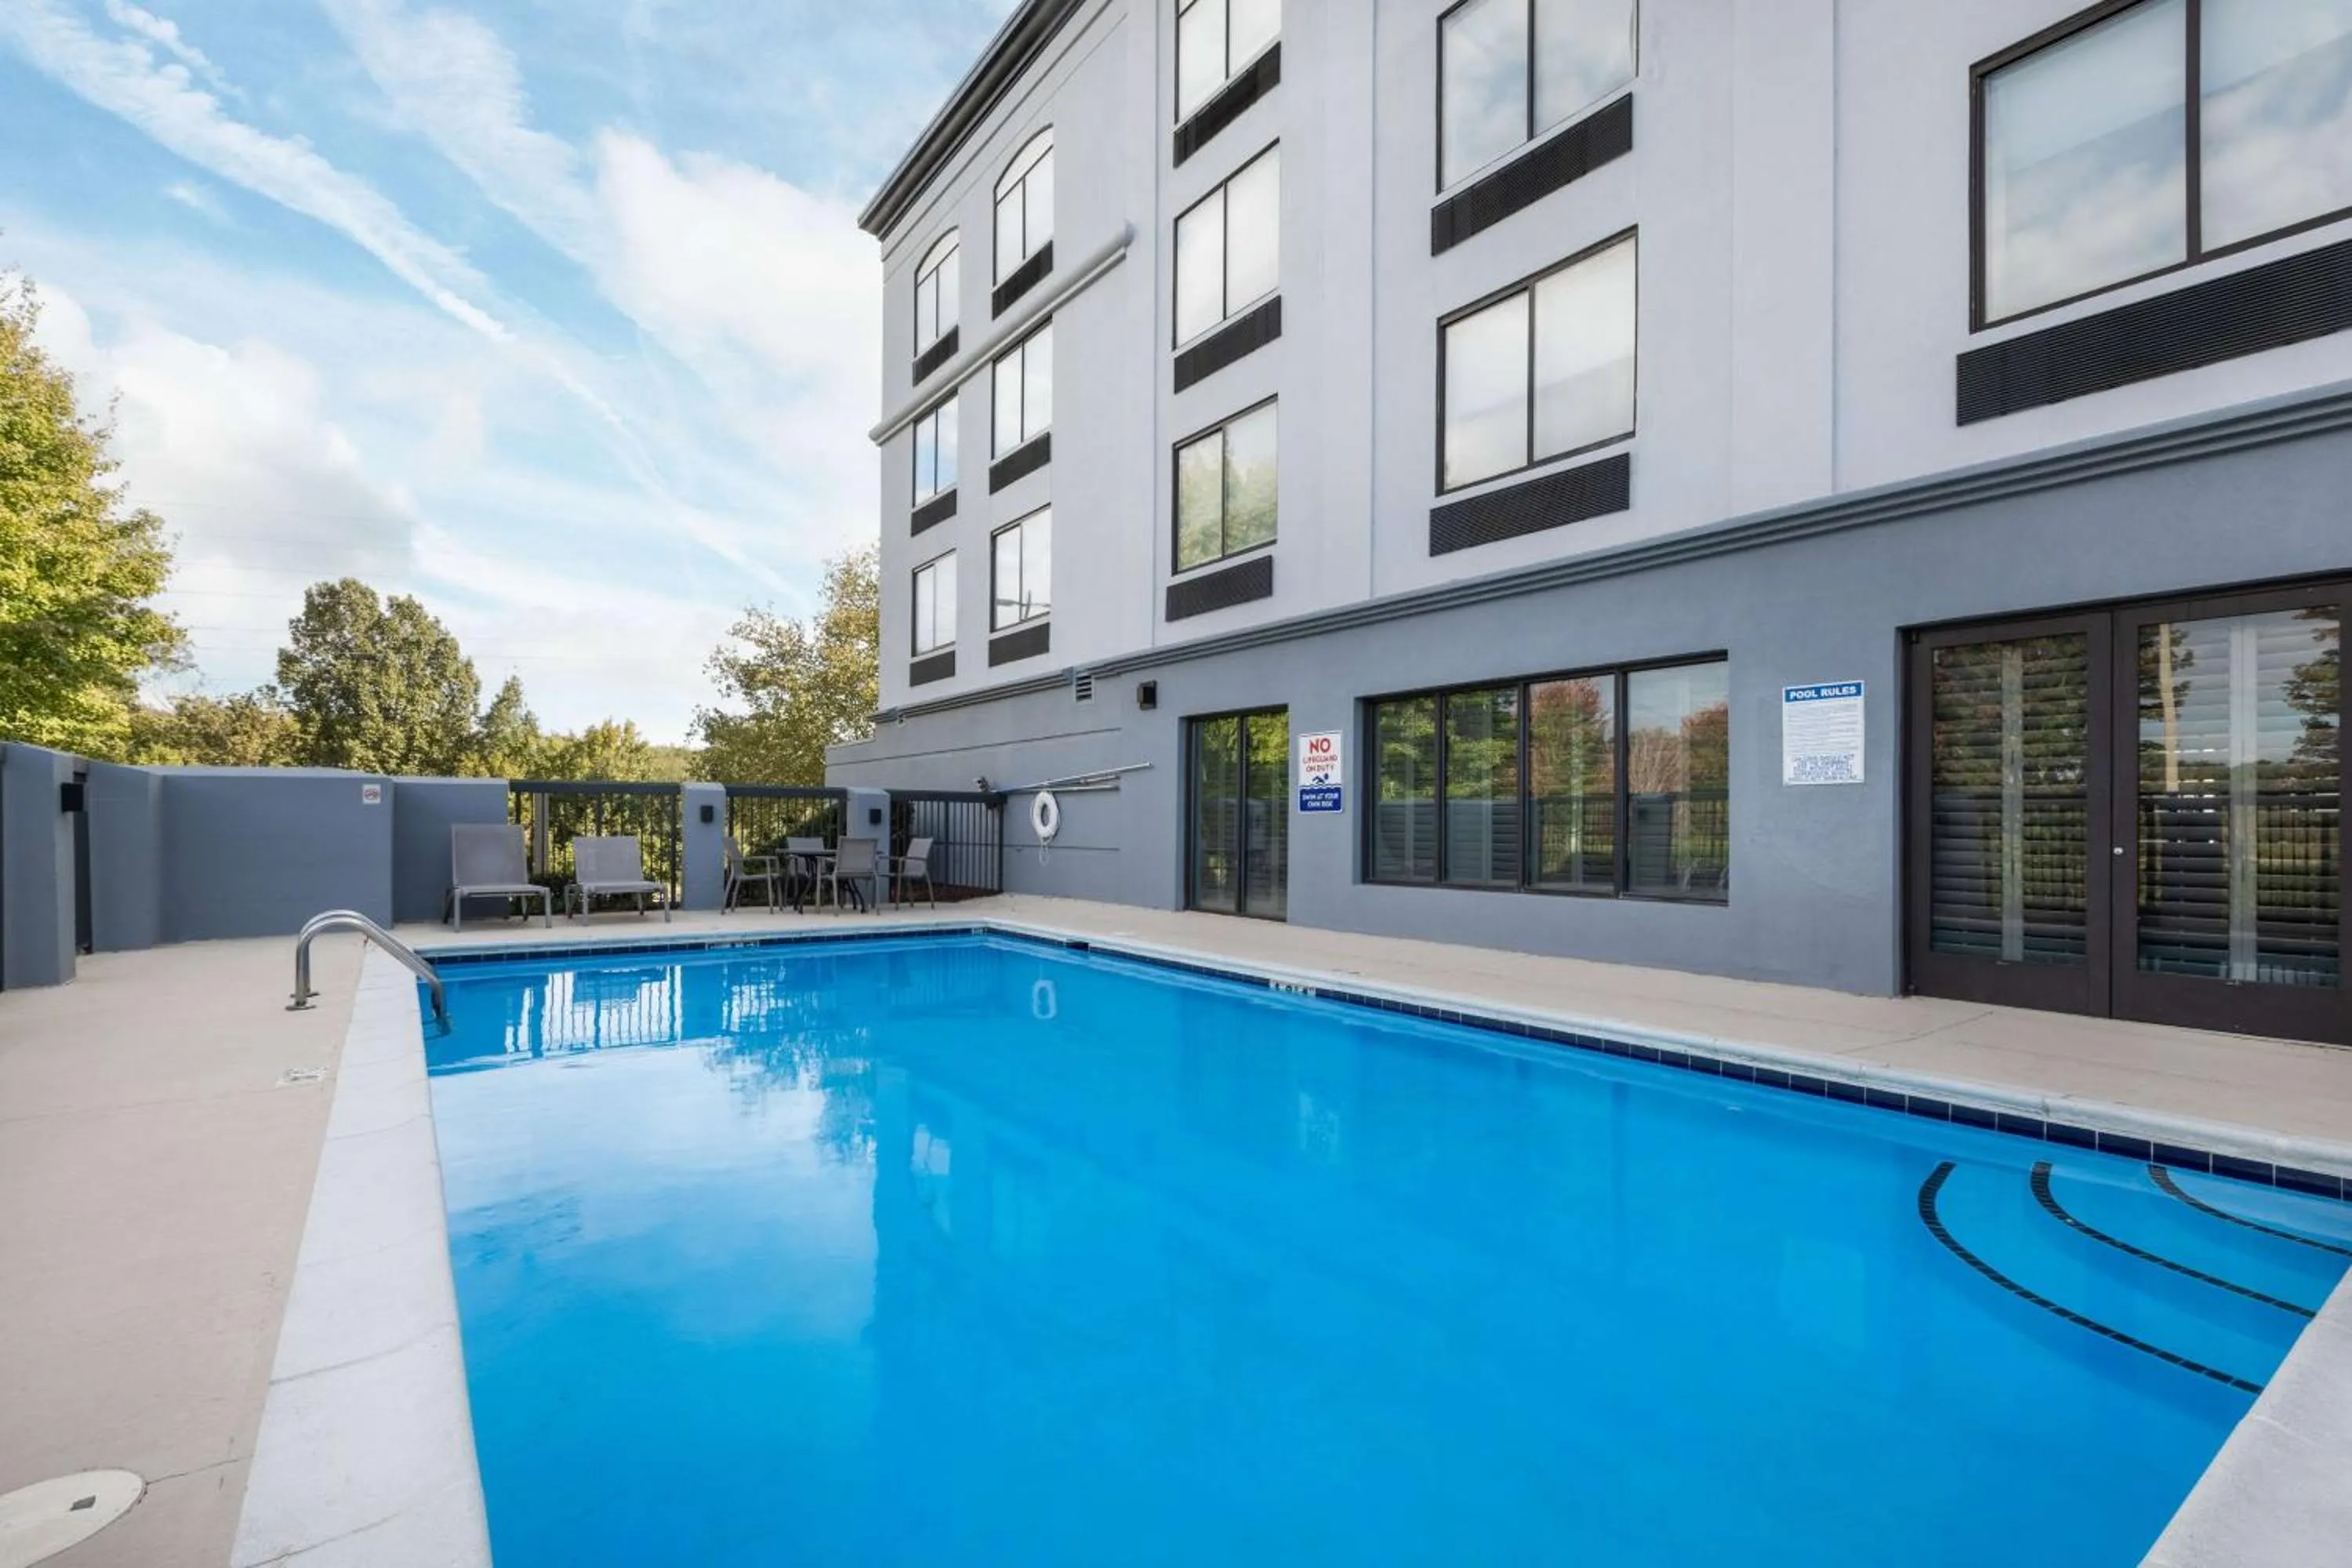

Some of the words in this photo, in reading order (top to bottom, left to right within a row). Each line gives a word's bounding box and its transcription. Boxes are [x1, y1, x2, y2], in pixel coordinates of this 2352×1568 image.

[1790, 689, 1818, 699] POOL
[1820, 685, 1857, 697] RULES
[1309, 738, 1330, 753] NO
